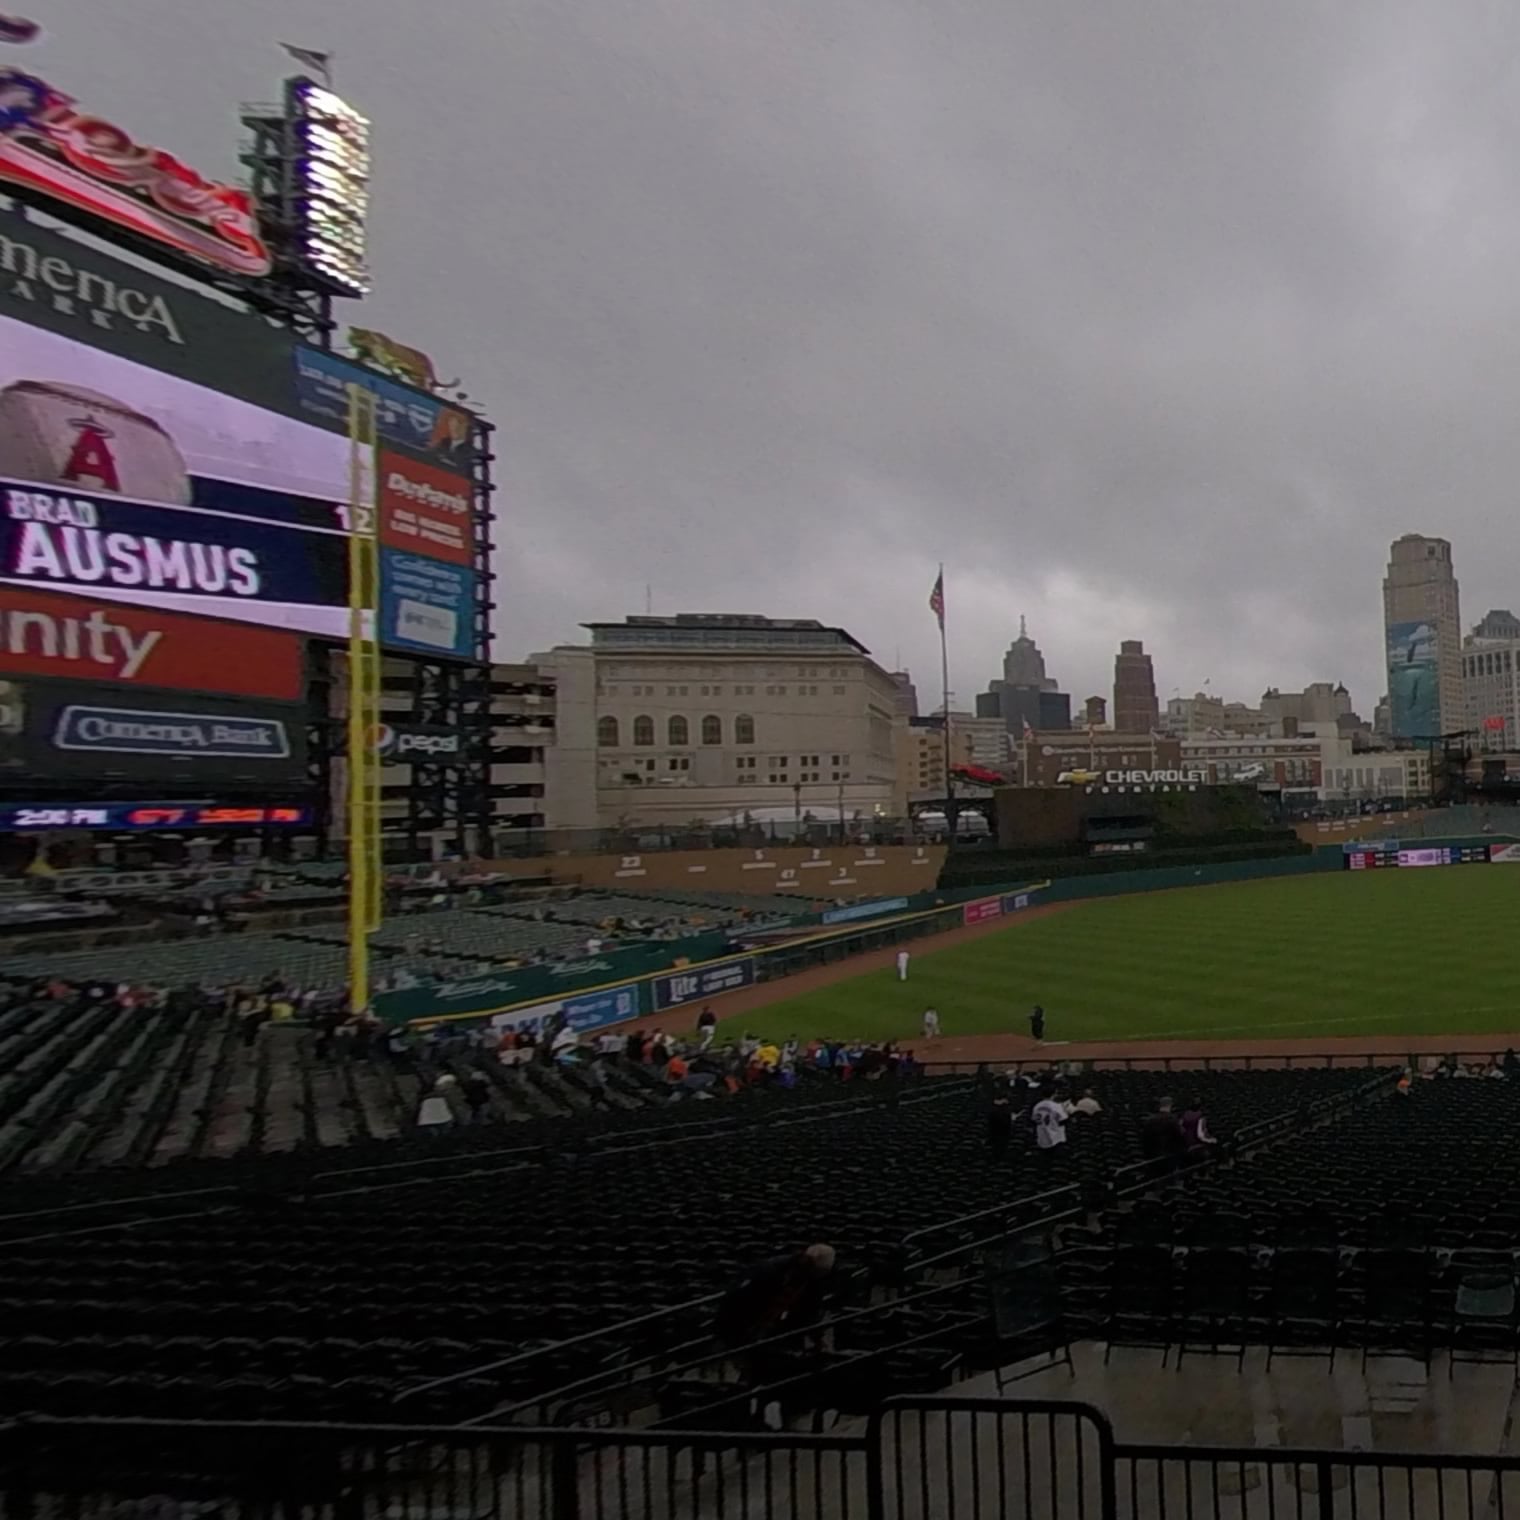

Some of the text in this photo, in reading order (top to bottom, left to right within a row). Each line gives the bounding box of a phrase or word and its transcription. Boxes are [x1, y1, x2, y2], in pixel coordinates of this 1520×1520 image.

[7, 489, 98, 528] BRAD
[16, 521, 260, 596] AUSMUS
[210, 724, 273, 748] Bank
[399, 731, 459, 755] pepsi
[1105, 769, 1209, 784] CHEVROLET
[1085, 784, 1197, 795] FOUNTAIN
[669, 976, 698, 1003] Lite
